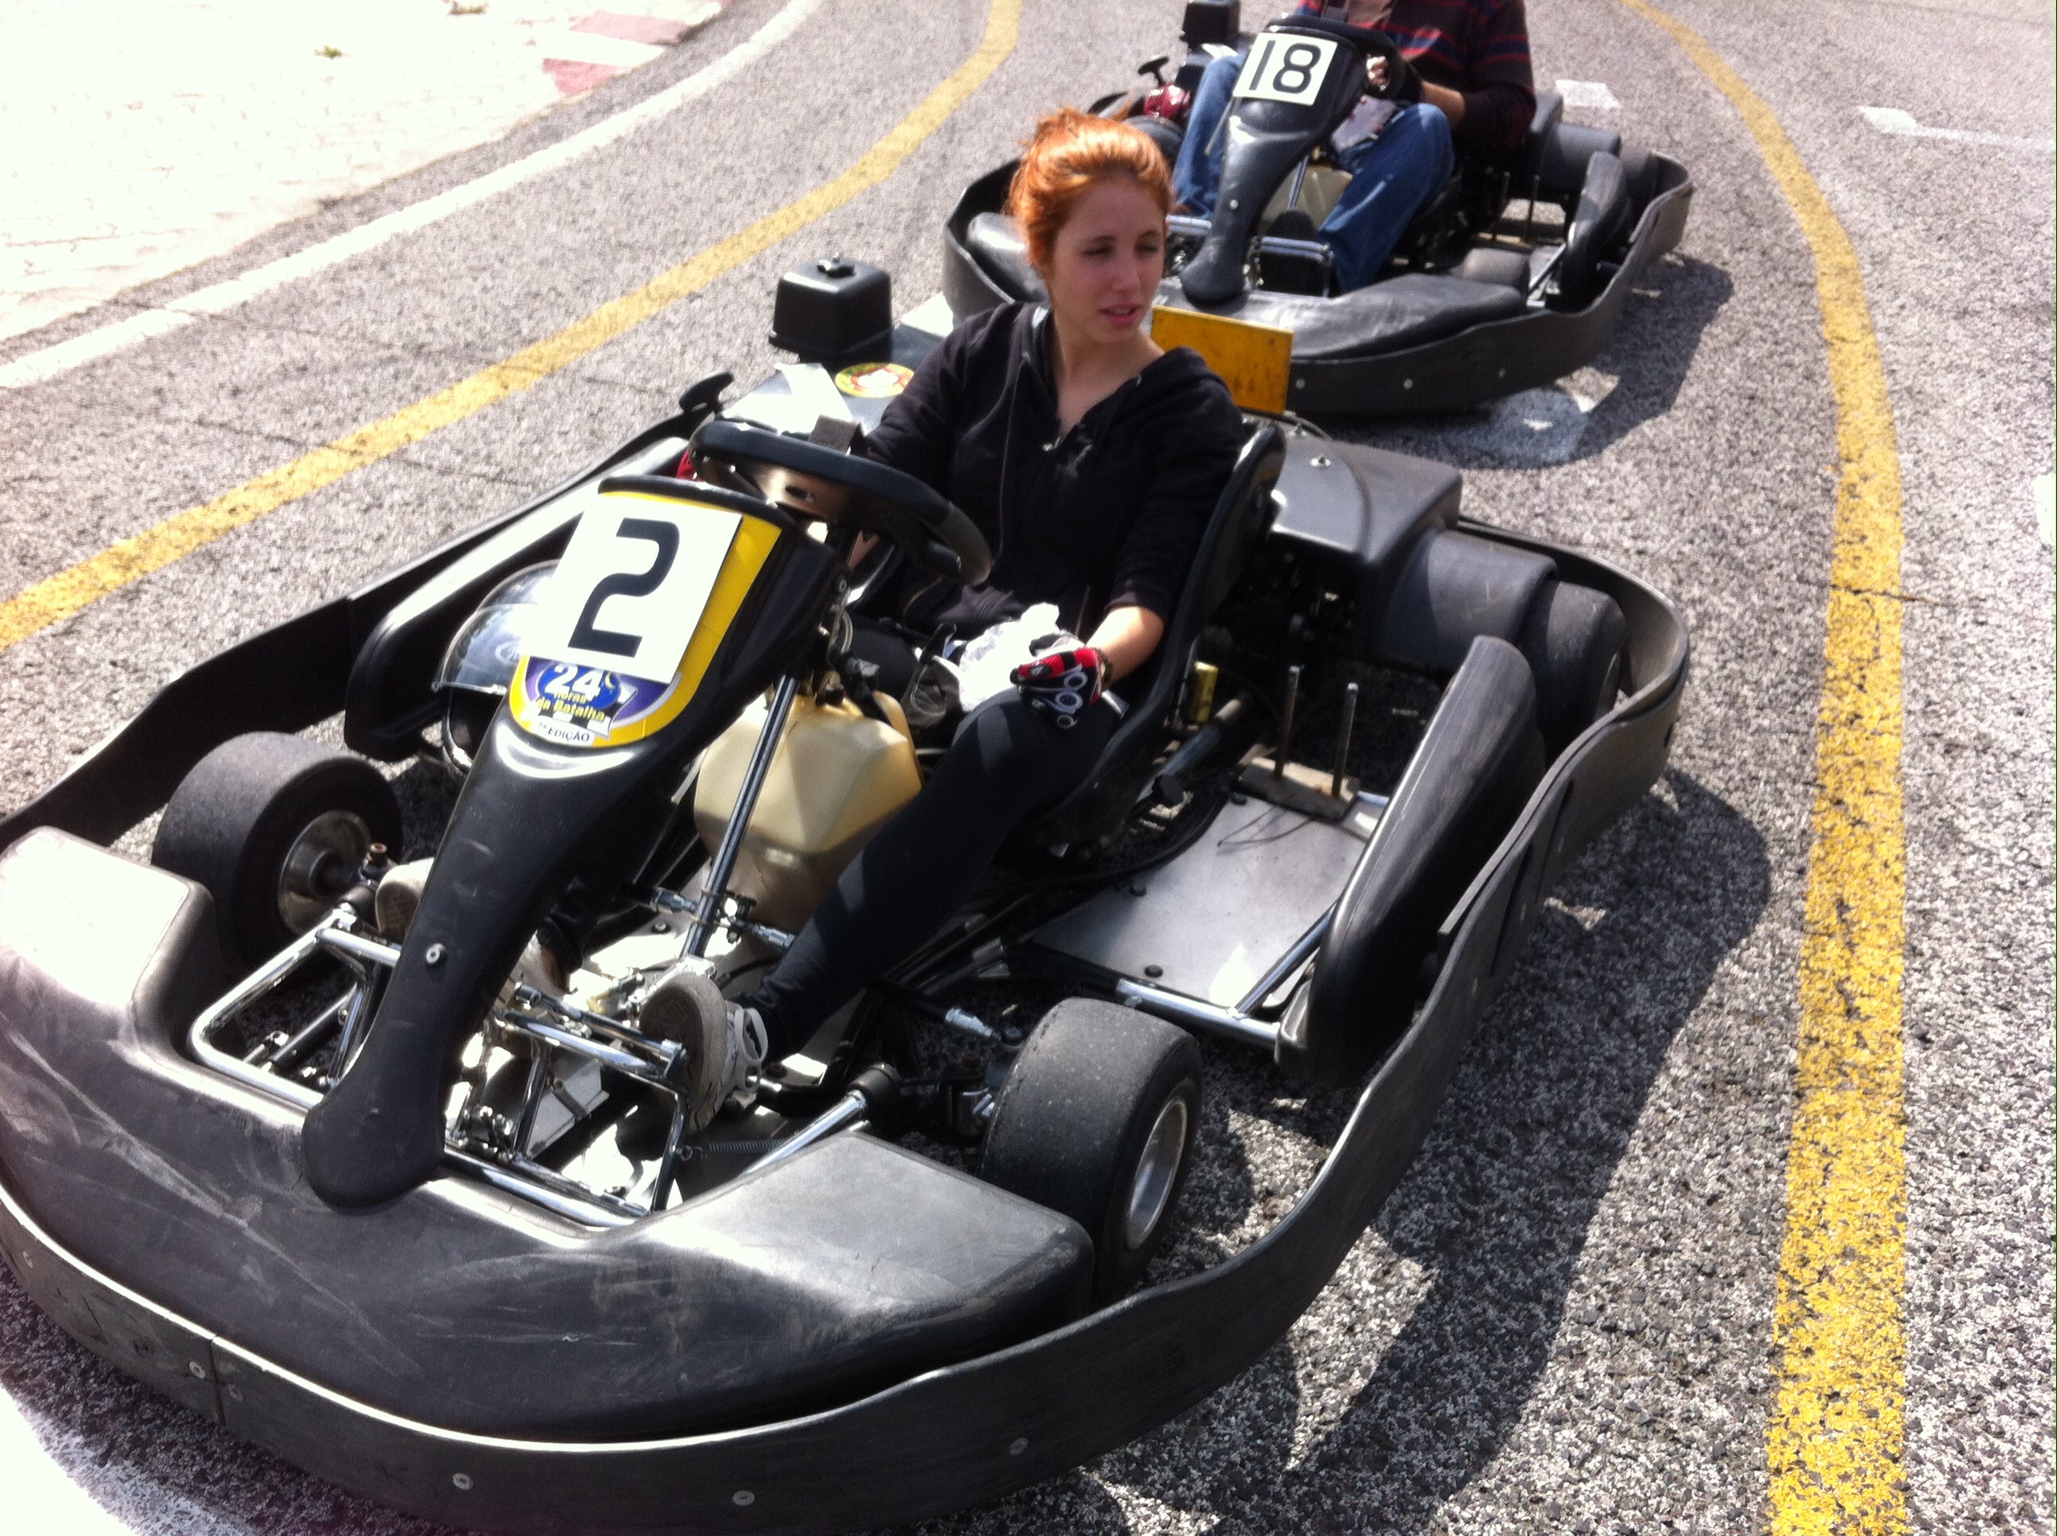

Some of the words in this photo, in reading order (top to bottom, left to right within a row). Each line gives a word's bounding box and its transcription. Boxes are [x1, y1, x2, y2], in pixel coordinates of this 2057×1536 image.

[1249, 40, 1322, 94] 18
[567, 517, 680, 658] 2
[544, 663, 602, 701] 24
[553, 699, 606, 722] Batalha
[548, 727, 590, 742] EDIÇÃO
